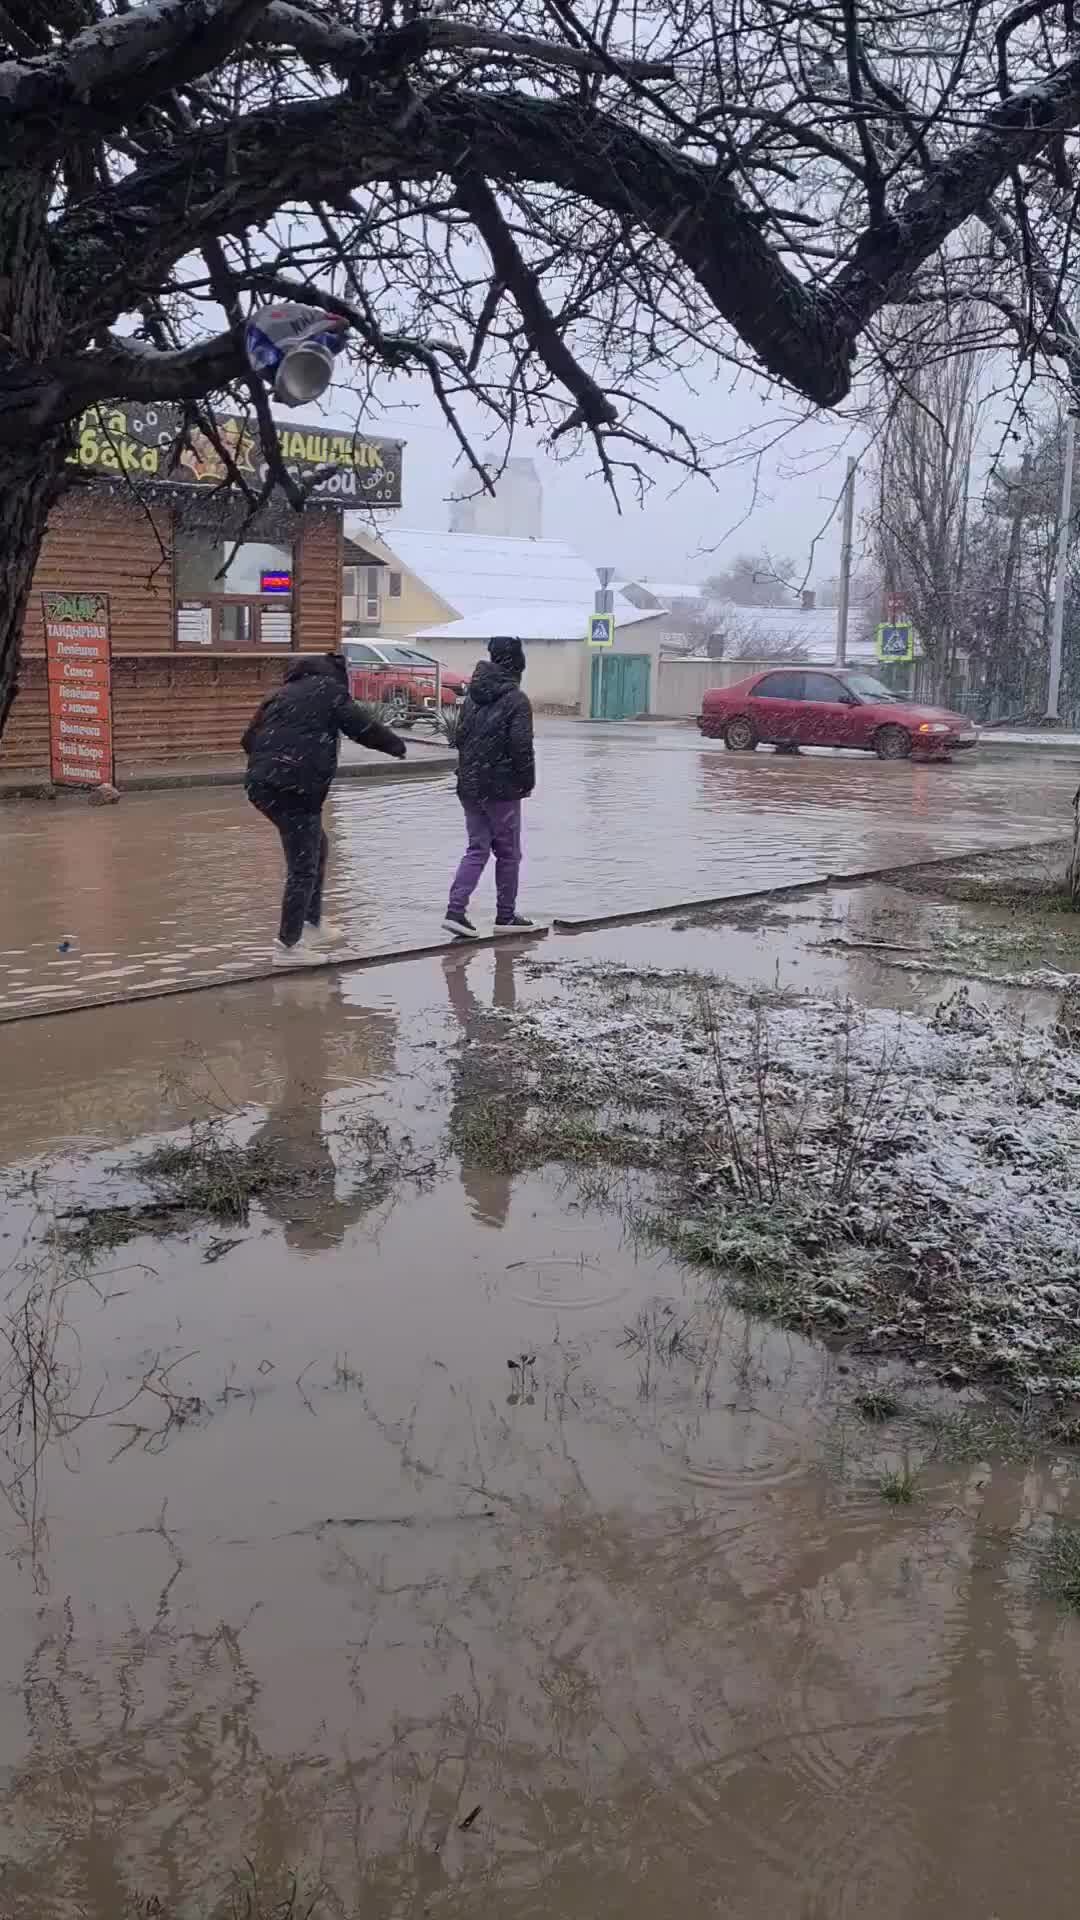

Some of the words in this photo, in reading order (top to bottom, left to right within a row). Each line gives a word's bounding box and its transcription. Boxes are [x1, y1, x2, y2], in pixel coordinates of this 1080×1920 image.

[46, 624, 106, 639] ТАНДЫРНАЯ
[63, 664, 94, 677] Самса
[60, 721, 100, 736] Выпечка
[59, 741, 77, 755] Чай
